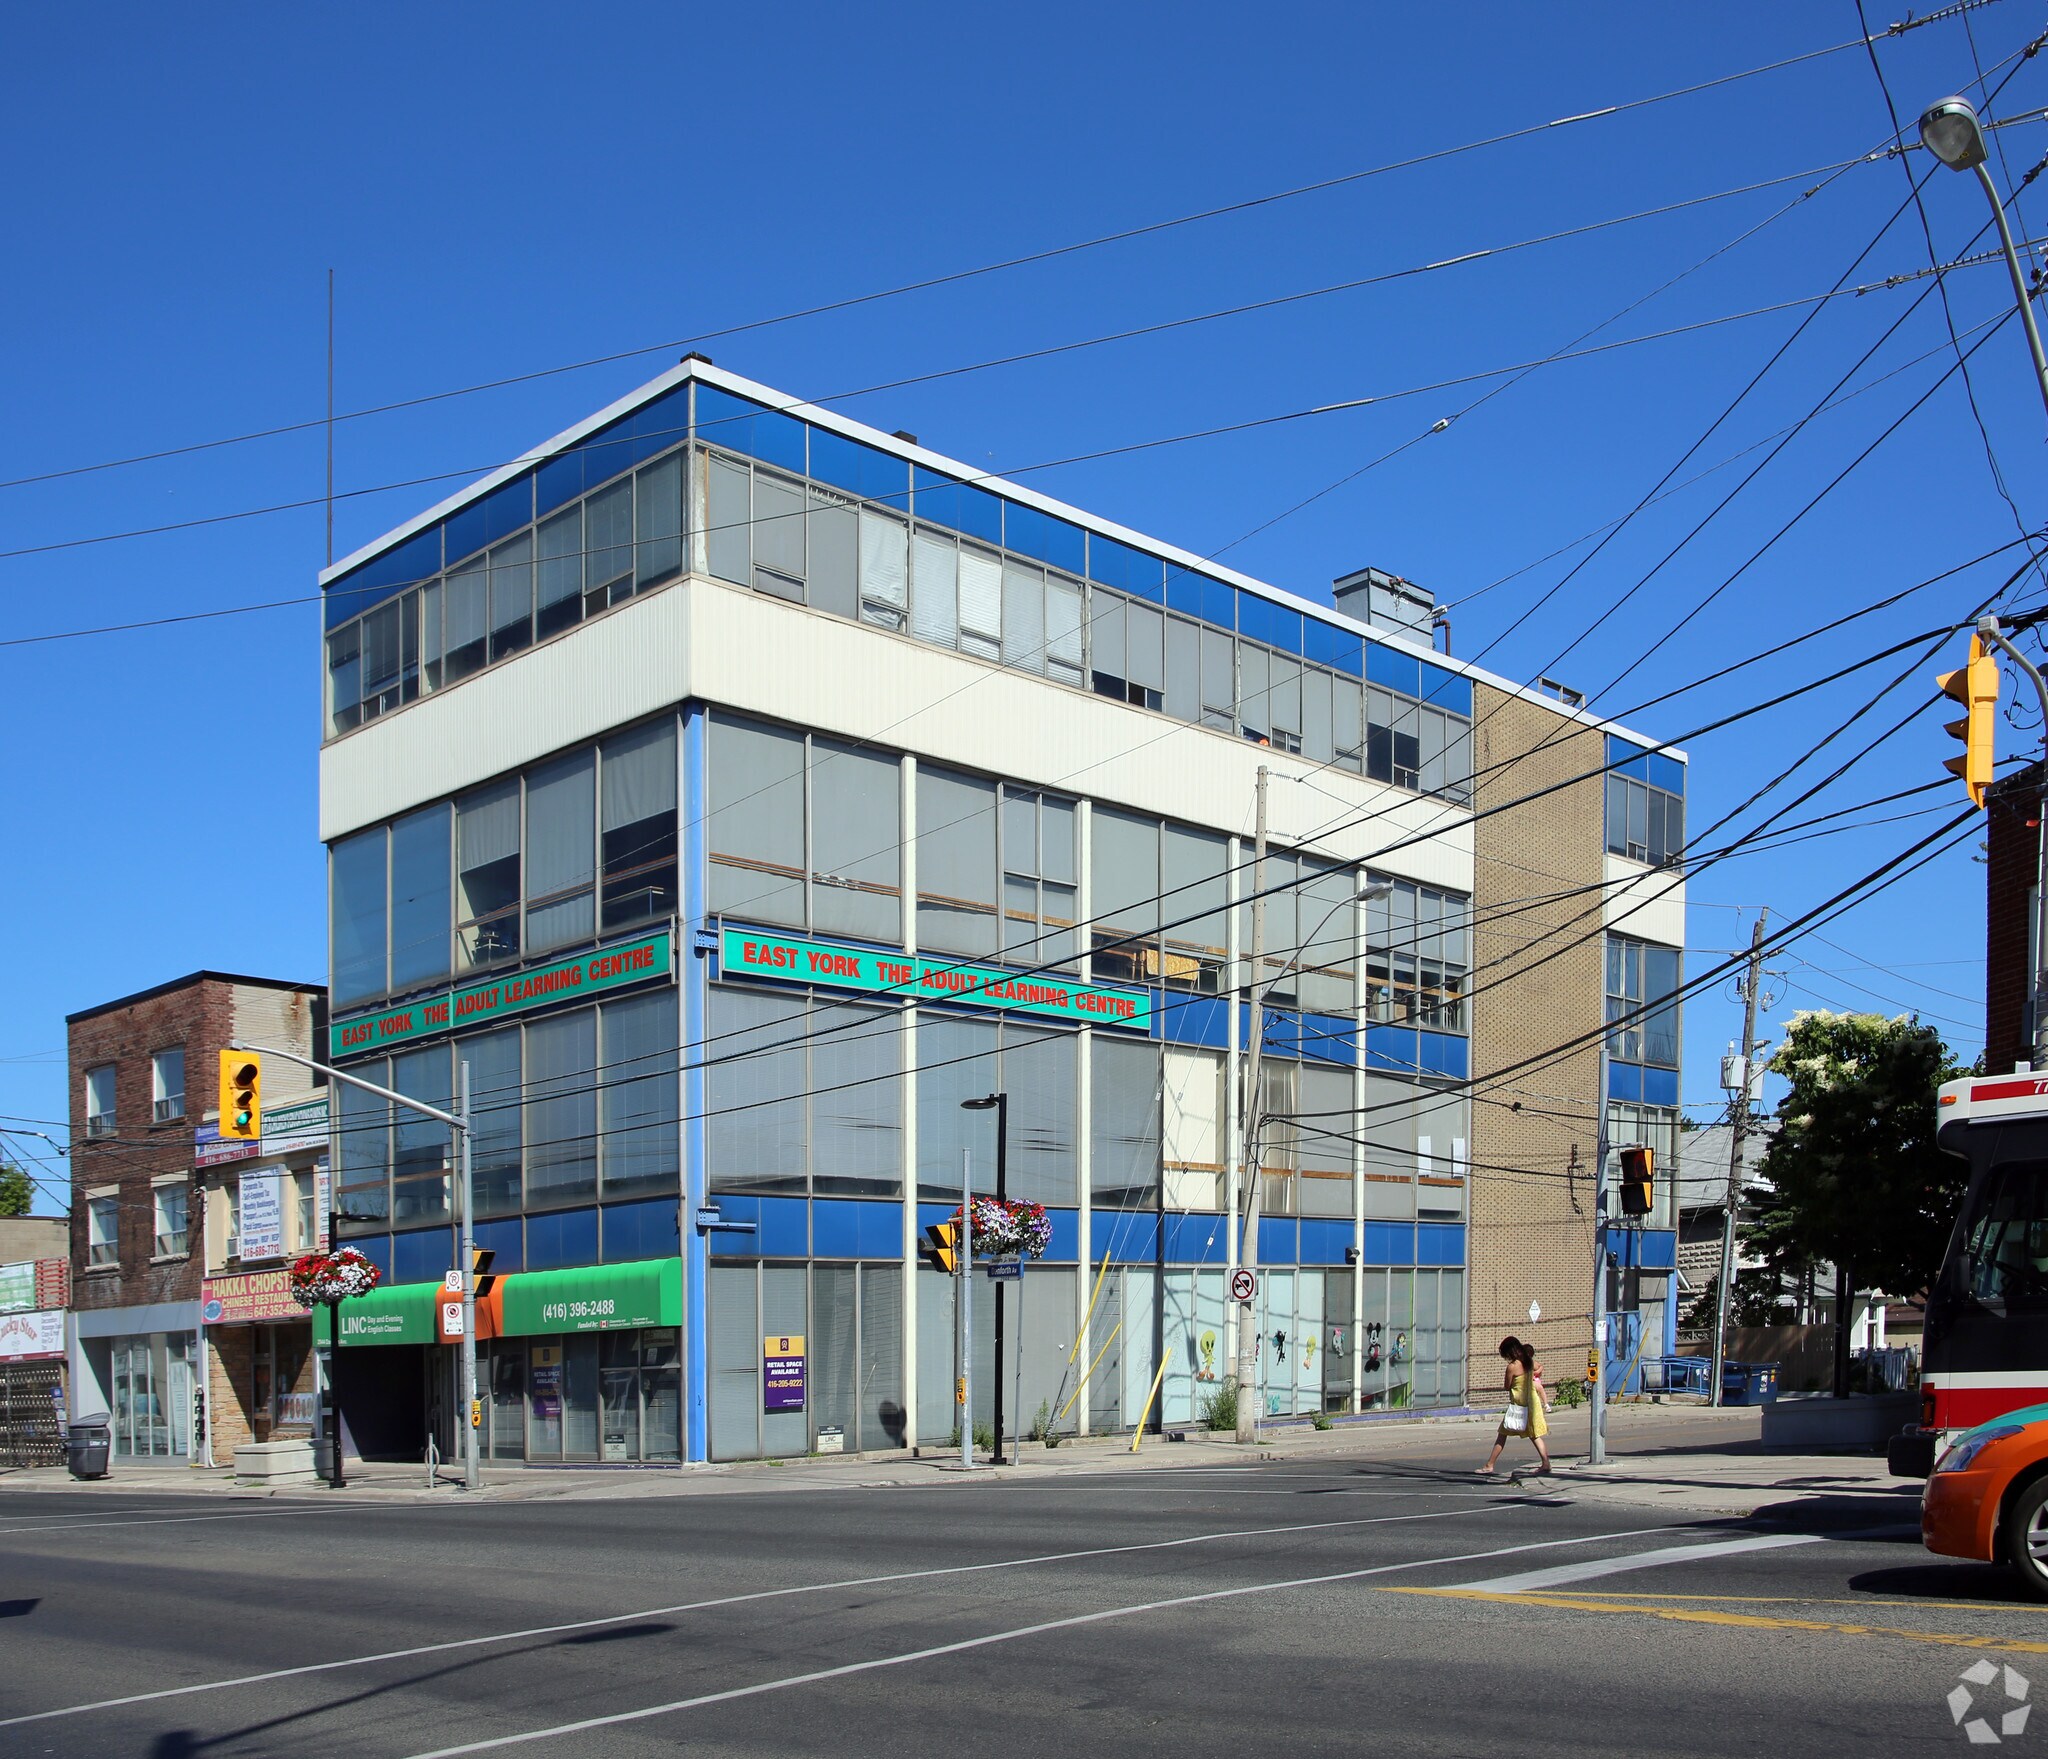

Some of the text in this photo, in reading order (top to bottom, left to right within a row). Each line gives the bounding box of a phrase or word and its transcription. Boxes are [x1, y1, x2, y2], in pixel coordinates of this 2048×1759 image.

[743, 941, 1137, 1018] EAST YORK THE ADULT LEARNING CENTRE
[342, 945, 655, 1047] EAST YORK THE ADULT LEARNING CENTRE
[212, 1276, 247, 1298] HAKKA
[221, 1291, 297, 1309] CHINESE RESTAURA
[543, 1299, 615, 1322] (416) 396-2488
[0, 1315, 19, 1338] ucky
[341, 1315, 403, 1335] LINC Day and Evening
[367, 1324, 402, 1334] English Classes
[577, 1321, 591, 1329] Funded
